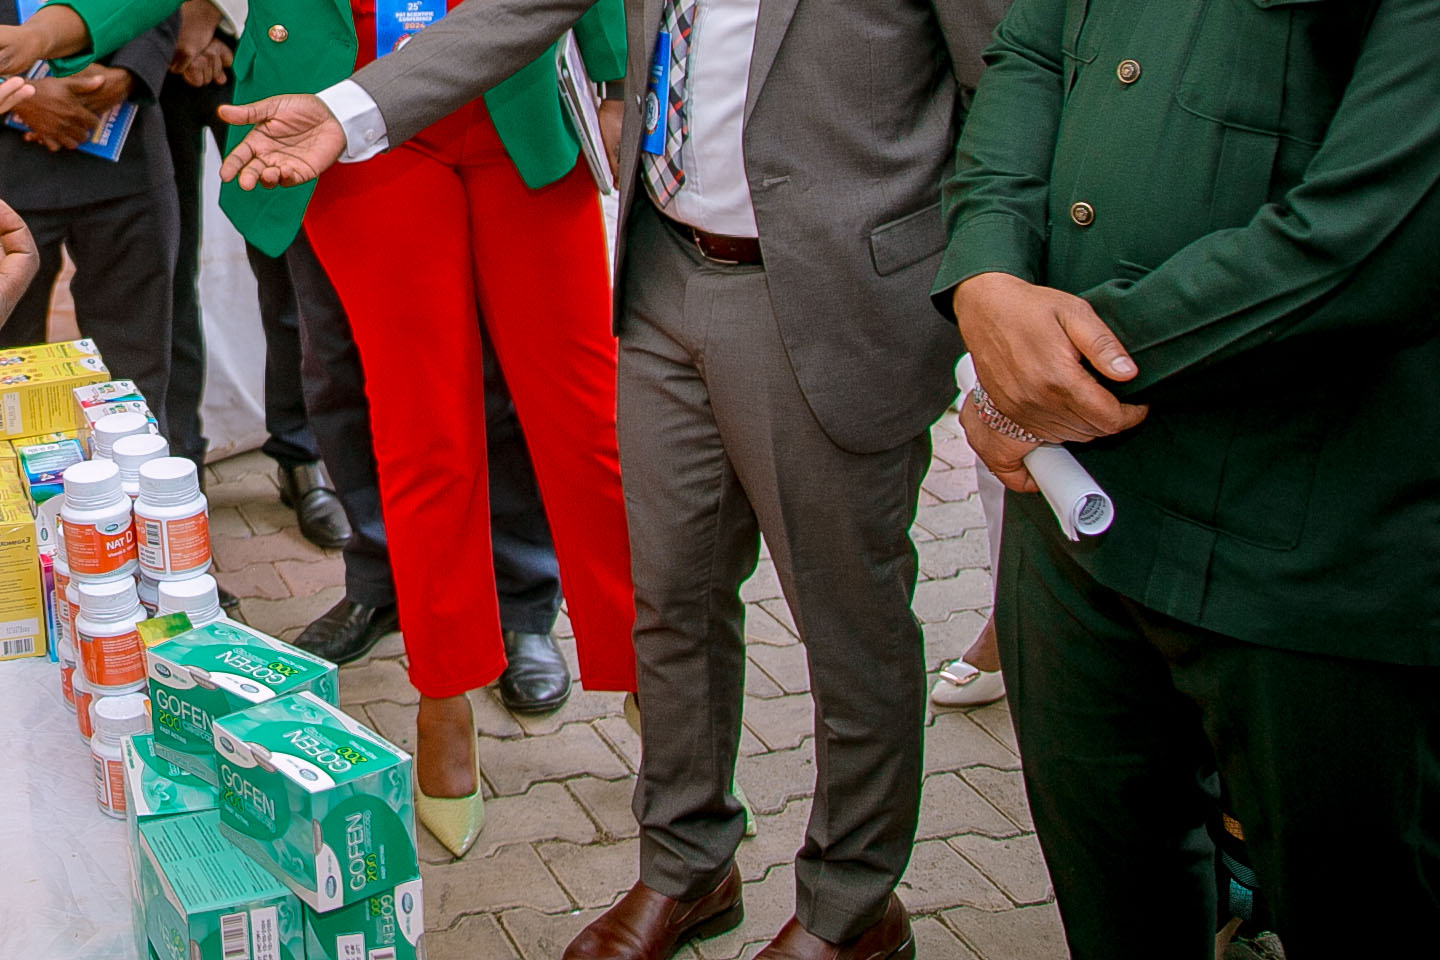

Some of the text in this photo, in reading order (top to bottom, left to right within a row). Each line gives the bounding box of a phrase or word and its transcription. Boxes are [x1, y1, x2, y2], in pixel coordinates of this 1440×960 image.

[106, 530, 133, 551] NAT D
[215, 650, 286, 685] GOFEN
[268, 661, 298, 679] 200
[155, 689, 215, 733] GOFEN
[158, 710, 181, 732] 200
[283, 729, 351, 773] GOFEN
[337, 745, 368, 766] 200
[220, 764, 276, 821] GOFEN
[345, 812, 367, 891] GOFEN
[366, 853, 378, 883] 200
[380, 894, 396, 945] GOFEN
